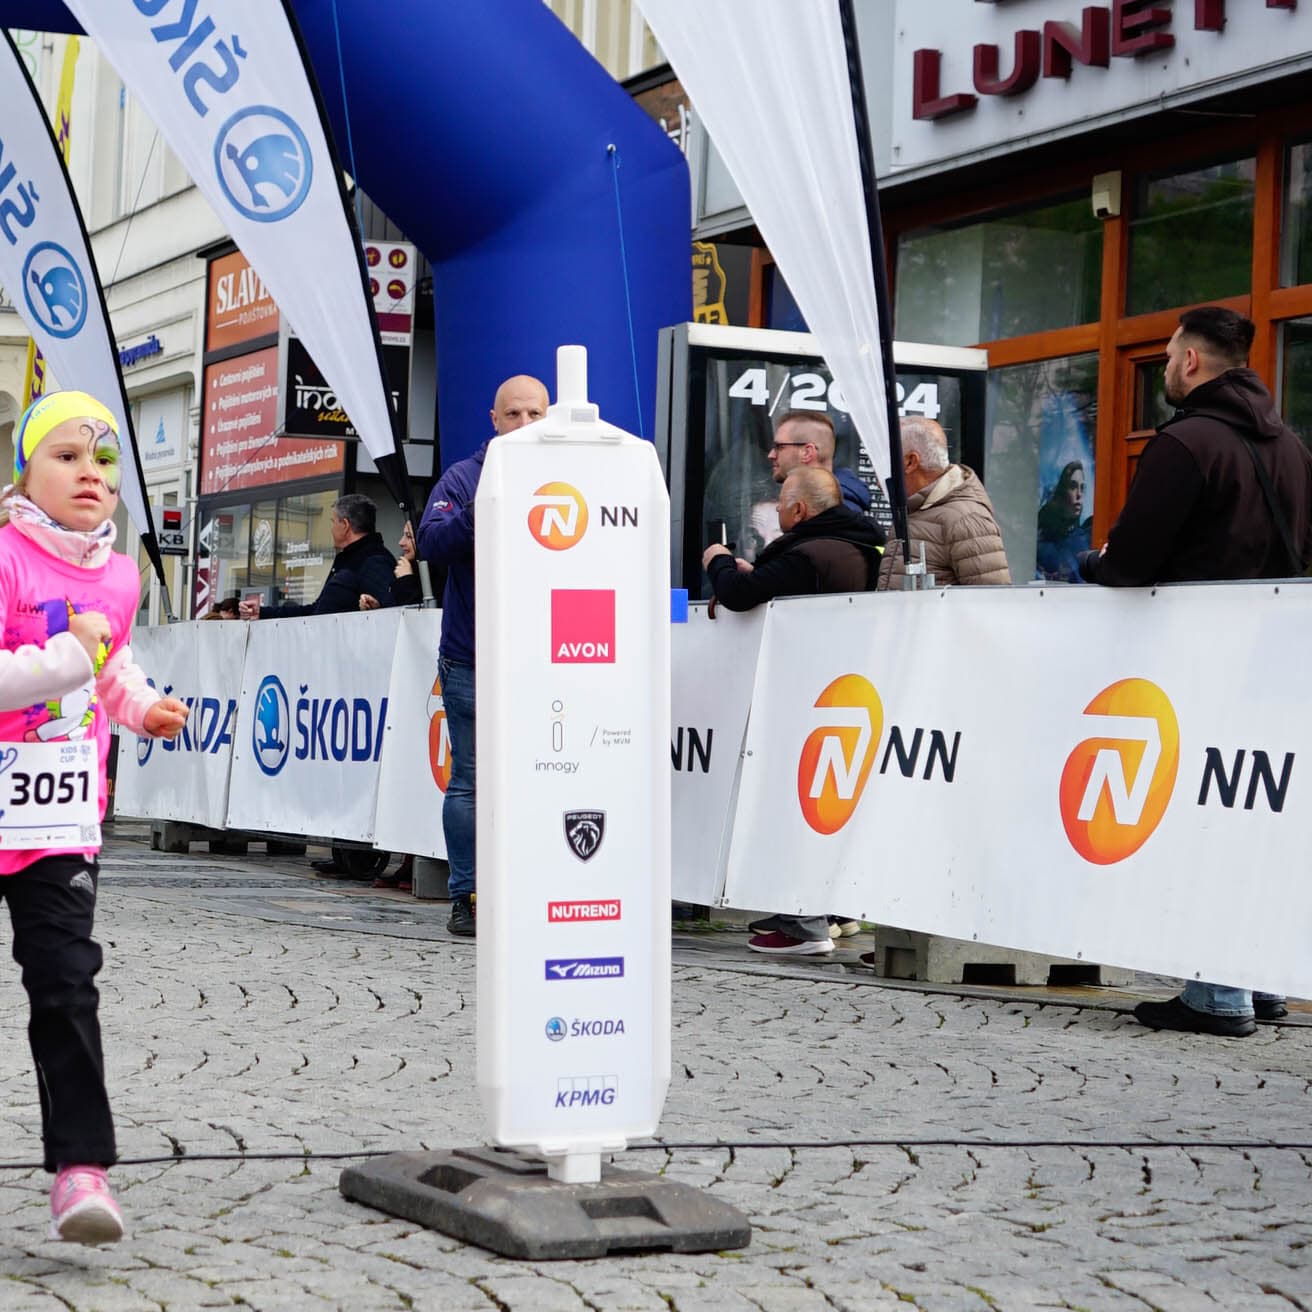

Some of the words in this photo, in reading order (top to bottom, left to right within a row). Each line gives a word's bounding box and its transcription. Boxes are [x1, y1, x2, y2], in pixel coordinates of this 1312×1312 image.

[600, 505, 639, 528] NN
[159, 533, 185, 546] KB
[557, 642, 609, 658] AVON
[602, 728, 632, 736] Powered
[602, 737, 611, 746] by
[614, 737, 632, 745] MVM
[60, 746, 78, 754] KIDS
[879, 724, 962, 783] NN
[535, 759, 580, 773] innogy
[1197, 745, 1296, 814] NN
[9, 770, 89, 806] 3051
[566, 813, 603, 821] PEUGEOT
[551, 902, 619, 919] NUTREND
[571, 1018, 625, 1037] ŠKODA
[554, 1088, 616, 1108] KPMG
